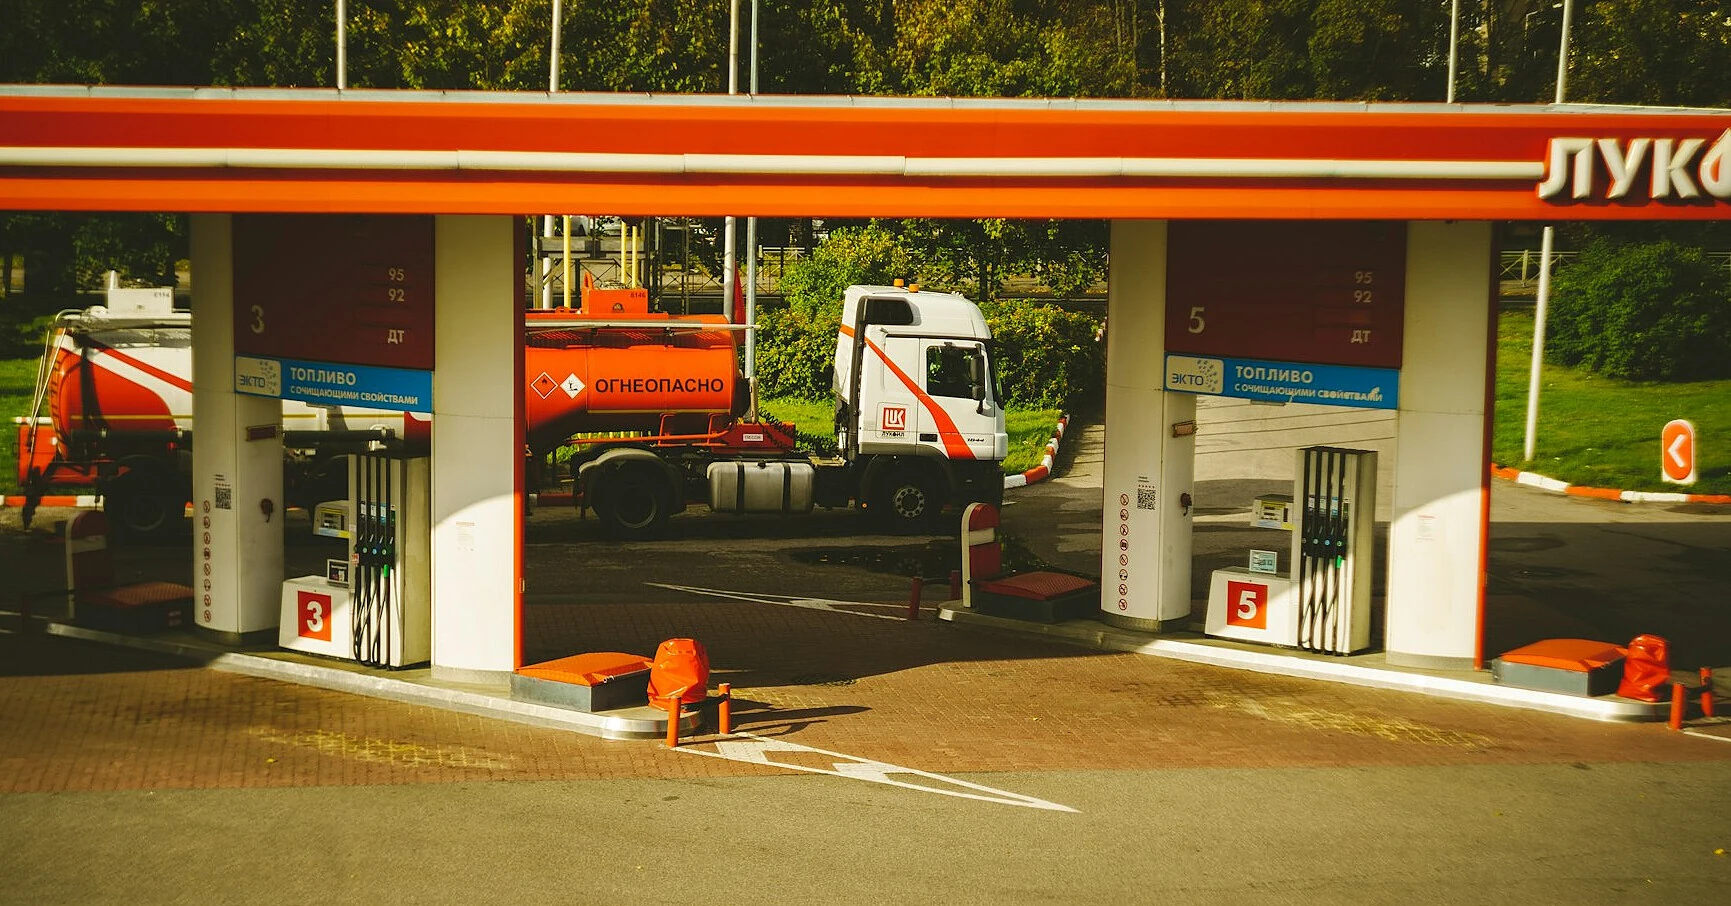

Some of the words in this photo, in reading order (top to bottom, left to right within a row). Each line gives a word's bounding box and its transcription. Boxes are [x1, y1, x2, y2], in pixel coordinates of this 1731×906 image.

[388, 268, 405, 281] 95
[1355, 271, 1373, 284] 95
[388, 289, 405, 302] 92
[1354, 290, 1373, 303] 92
[251, 304, 265, 334] 3
[1187, 306, 1206, 334] 5
[387, 329, 405, 344] ДТ
[1351, 329, 1372, 343] ДТ
[239, 374, 266, 388] ЭКТО
[290, 366, 357, 386] ТОПЛИВО
[1171, 373, 1204, 386] ЭКТО
[1235, 365, 1313, 384] ТОПЛИВО
[595, 378, 724, 393] ОГНЕОПАСНО
[1234, 383, 1240, 391] С
[1241, 384, 1316, 398] ОЧИЩАЮЩИМИ
[1317, 389, 1383, 402] СВОЙСТВАМИ
[296, 386, 359, 401] ОЧИЩАЮЩИМИ
[360, 391, 418, 405] СВОЙСТВАМИ
[884, 409, 905, 428] LUK
[1237, 590, 1257, 620] 5
[306, 600, 324, 633] 3
